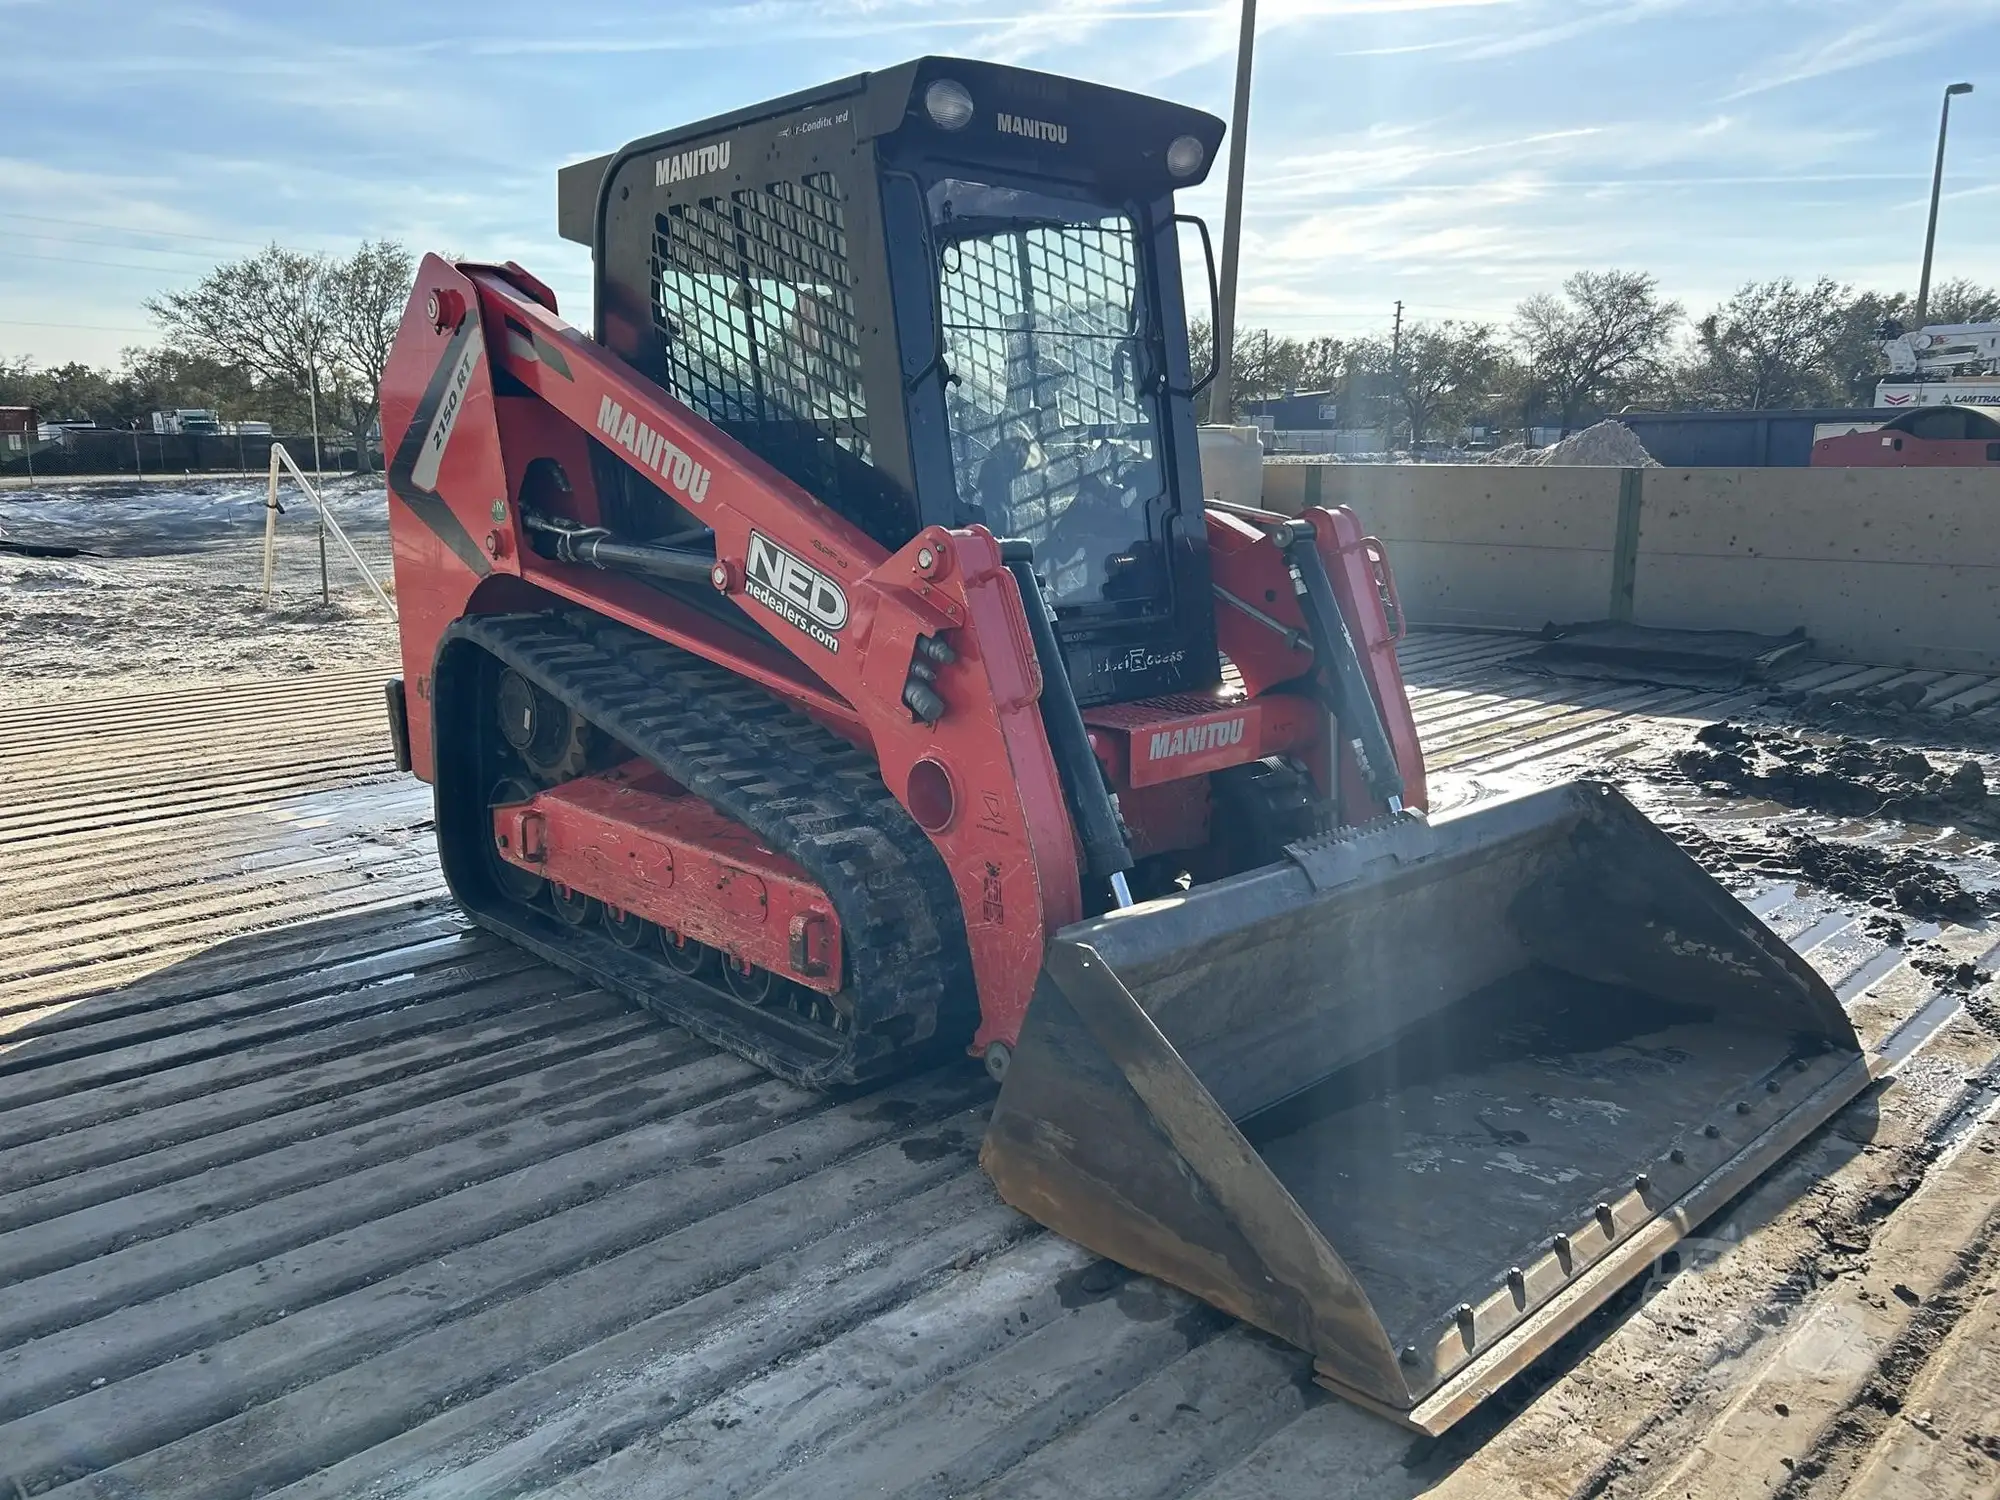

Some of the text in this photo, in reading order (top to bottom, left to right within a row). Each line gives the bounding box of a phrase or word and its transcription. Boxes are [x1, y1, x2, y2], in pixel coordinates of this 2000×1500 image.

[655, 140, 731, 187] MANITOU
[997, 112, 1068, 144] MANITOU
[433, 352, 473, 451] 2150 RT
[596, 394, 711, 503] MANITOU
[745, 580, 839, 652] nedealers.com
[748, 535, 847, 626] NED
[1149, 718, 1245, 760] MANITOU
